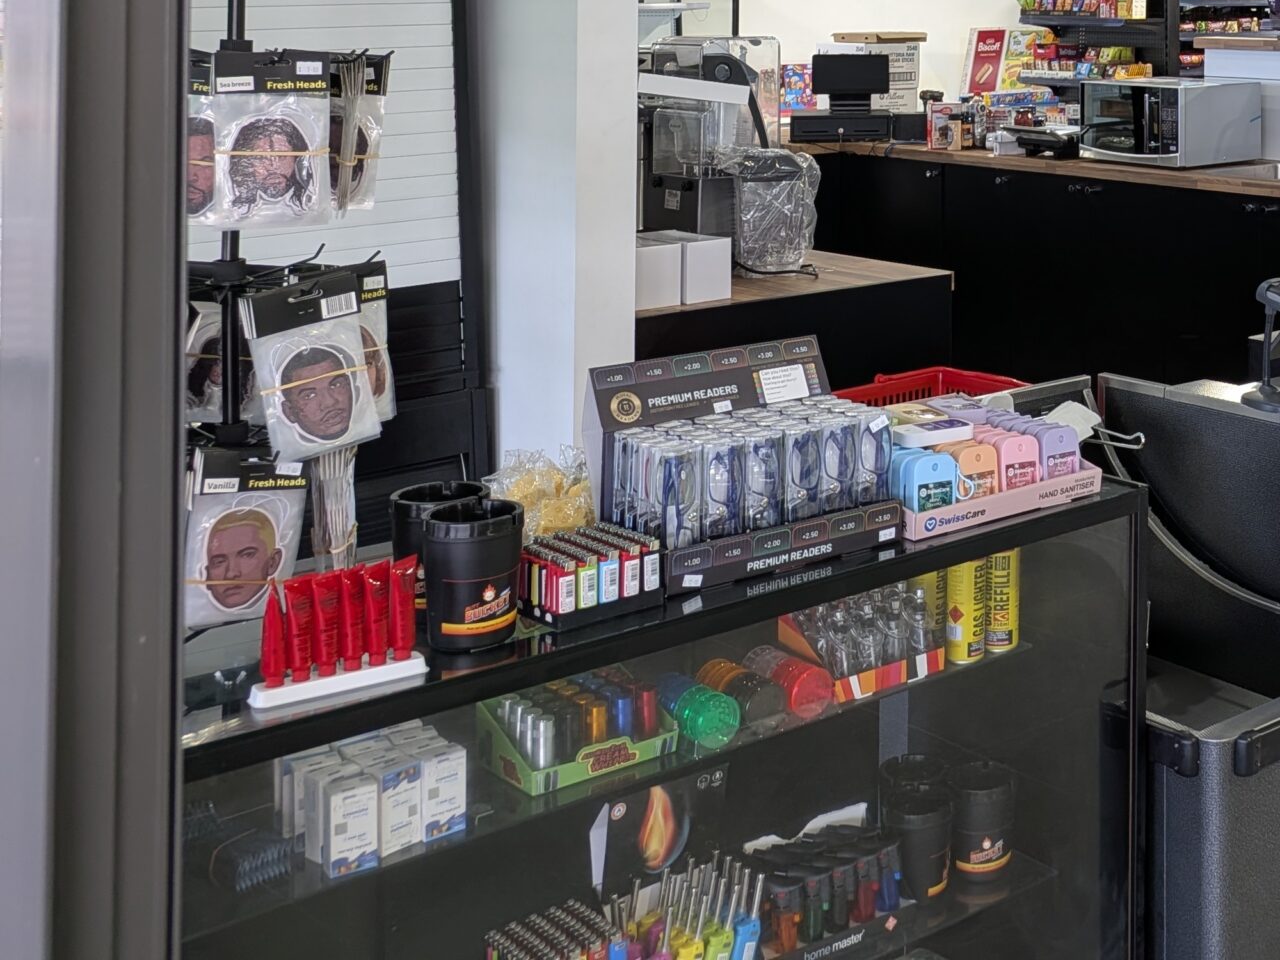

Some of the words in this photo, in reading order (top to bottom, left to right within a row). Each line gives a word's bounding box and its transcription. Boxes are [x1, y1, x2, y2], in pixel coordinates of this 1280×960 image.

[978, 41, 1001, 52] Biscoff
[219, 81, 231, 89] Sea
[232, 80, 252, 88] breeze
[267, 79, 294, 90] Fresh
[296, 79, 327, 90] Heads
[361, 288, 386, 301] Heads
[648, 391, 693, 408] PREMIUM
[694, 384, 738, 400] READERS
[207, 481, 236, 490] Vanilla
[248, 478, 275, 489] Fresh
[277, 477, 306, 487] Heads
[1038, 489, 1059, 501] HAND
[1060, 480, 1095, 497] SANITISER
[938, 508, 986, 527] SwissCare
[747, 553, 789, 572] PREMIUM
[790, 543, 833, 560] READERS
[973, 563, 986, 612] LIGHTER
[993, 571, 1010, 612] REFILL
[972, 613, 985, 638] GAS
[804, 944, 831, 960] home
